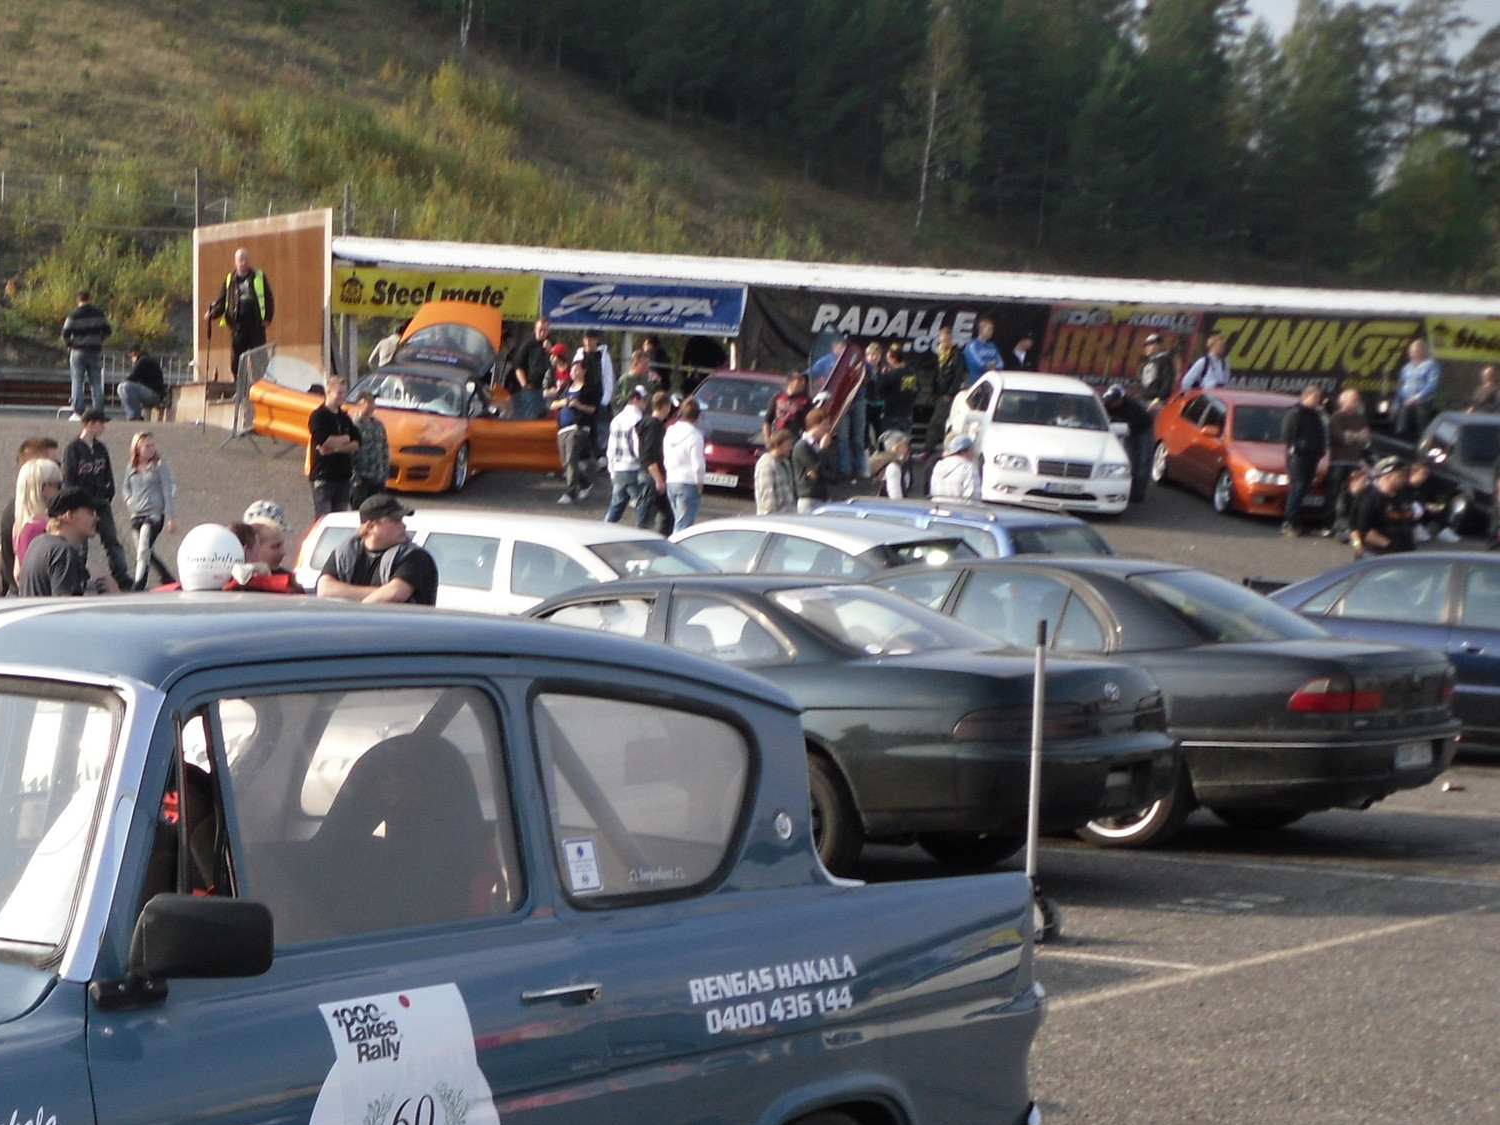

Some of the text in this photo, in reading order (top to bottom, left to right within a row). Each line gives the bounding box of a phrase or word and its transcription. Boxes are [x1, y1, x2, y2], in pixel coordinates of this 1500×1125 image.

[370, 279, 505, 307] Steel mate
[550, 284, 713, 317] SIMOTA
[811, 303, 978, 340] RADALLE
[689, 954, 858, 1004] RENGAS HAKALA
[332, 1003, 381, 1028] 1000
[706, 985, 853, 1035] 0400 436 144
[345, 1020, 398, 1043] Lakes
[357, 1038, 400, 1064] Rally
